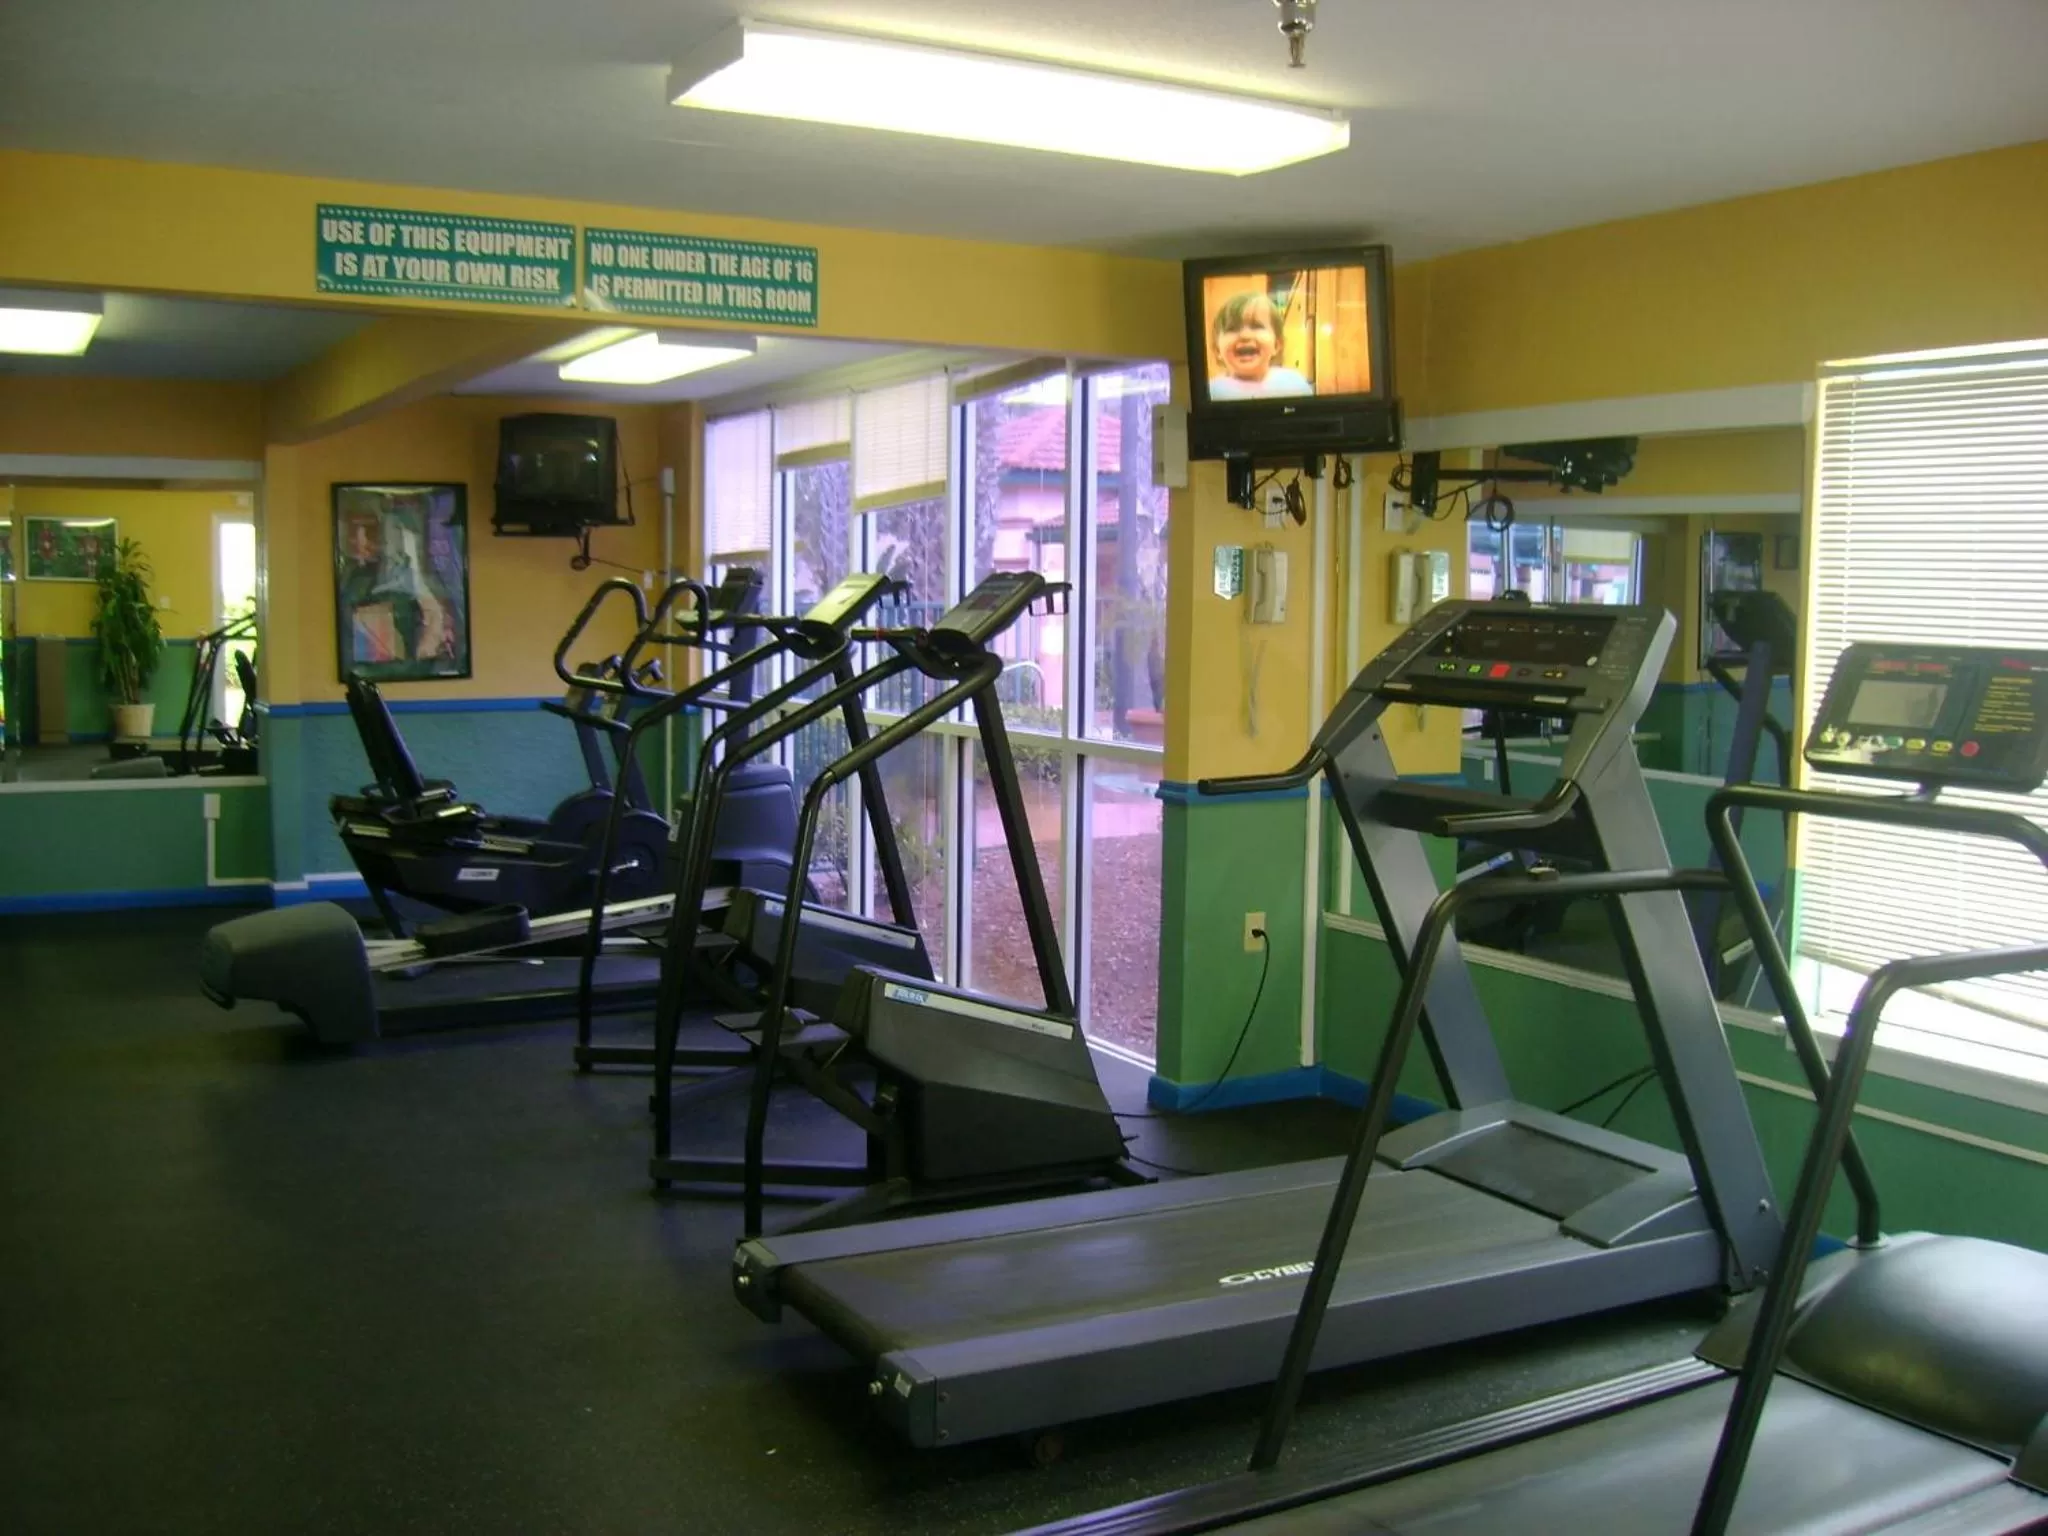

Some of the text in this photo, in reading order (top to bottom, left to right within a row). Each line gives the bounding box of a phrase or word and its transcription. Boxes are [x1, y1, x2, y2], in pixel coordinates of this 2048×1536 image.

[322, 219, 572, 261] USE OF THIS EQUIPMENT
[335, 252, 560, 290] IS AT YOUR OWN RISK
[590, 242, 814, 284] NO ONE UNDER THE AGE OF 16
[592, 273, 812, 313] IS PERMITTED IN THIS ROOM
[1252, 1260, 1315, 1281] CYBE
